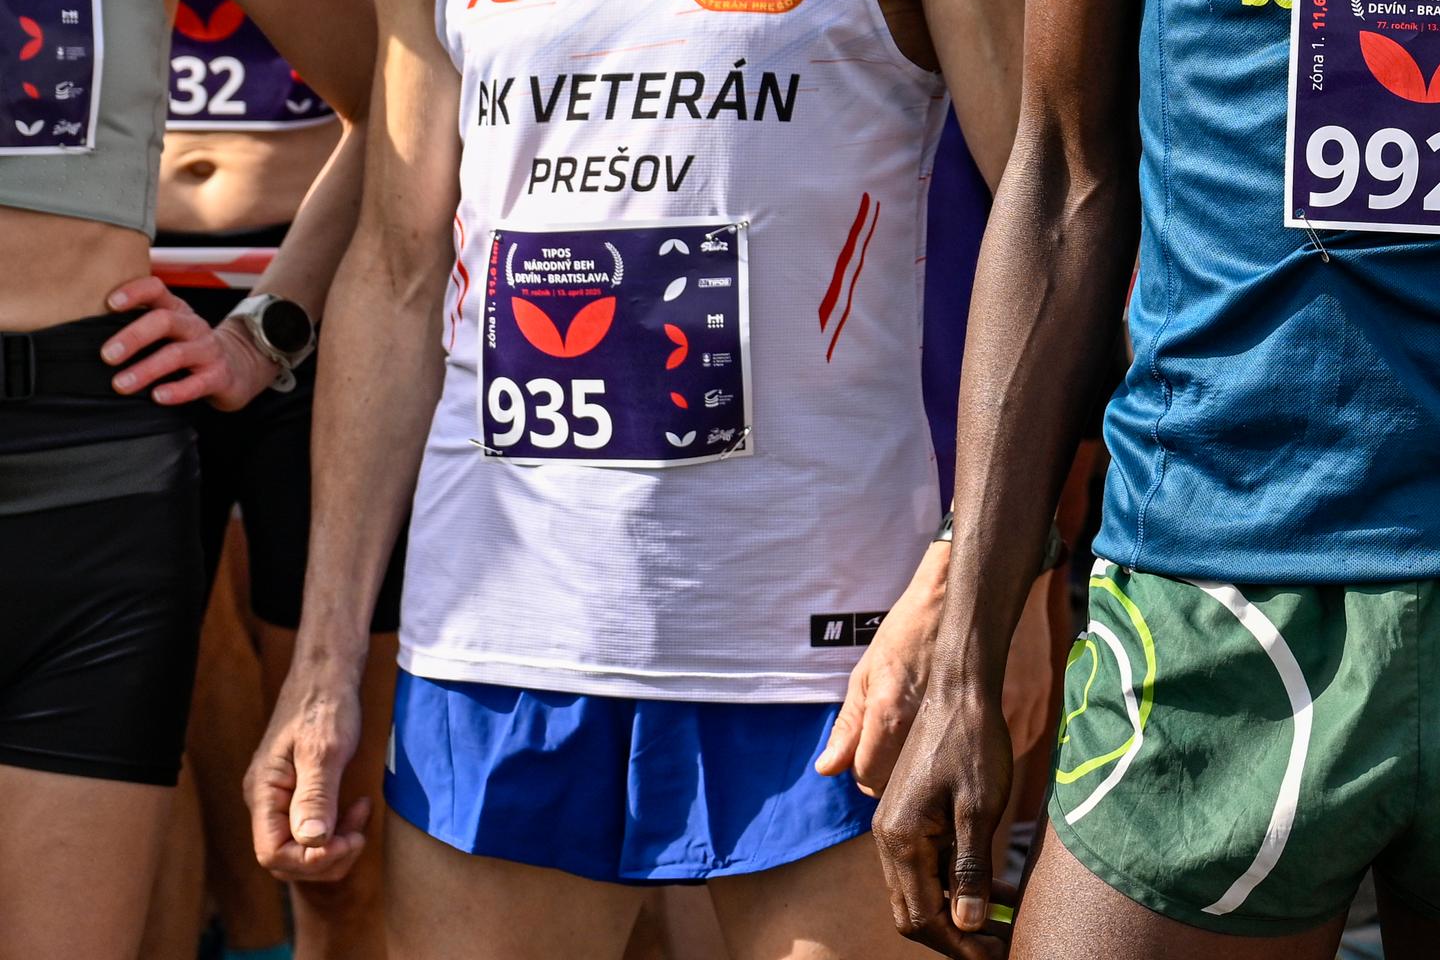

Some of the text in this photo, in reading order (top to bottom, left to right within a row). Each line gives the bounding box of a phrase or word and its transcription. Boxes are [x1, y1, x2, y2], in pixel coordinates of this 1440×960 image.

[1368, 3, 1406, 14] DEVÍN
[1312, 37, 1325, 50] 1.
[1309, 55, 1324, 91] zóna
[169, 55, 247, 115] 32
[530, 57, 800, 123] VETERÁN
[528, 146, 695, 195] PREŠOV
[541, 248, 572, 258] TIPOS
[523, 259, 595, 271] NÁRODNÝ BEH
[515, 272, 542, 283] DEVÍN
[547, 272, 610, 284] BRATISLAVA
[487, 376, 613, 449] 935
[823, 621, 844, 640] M
